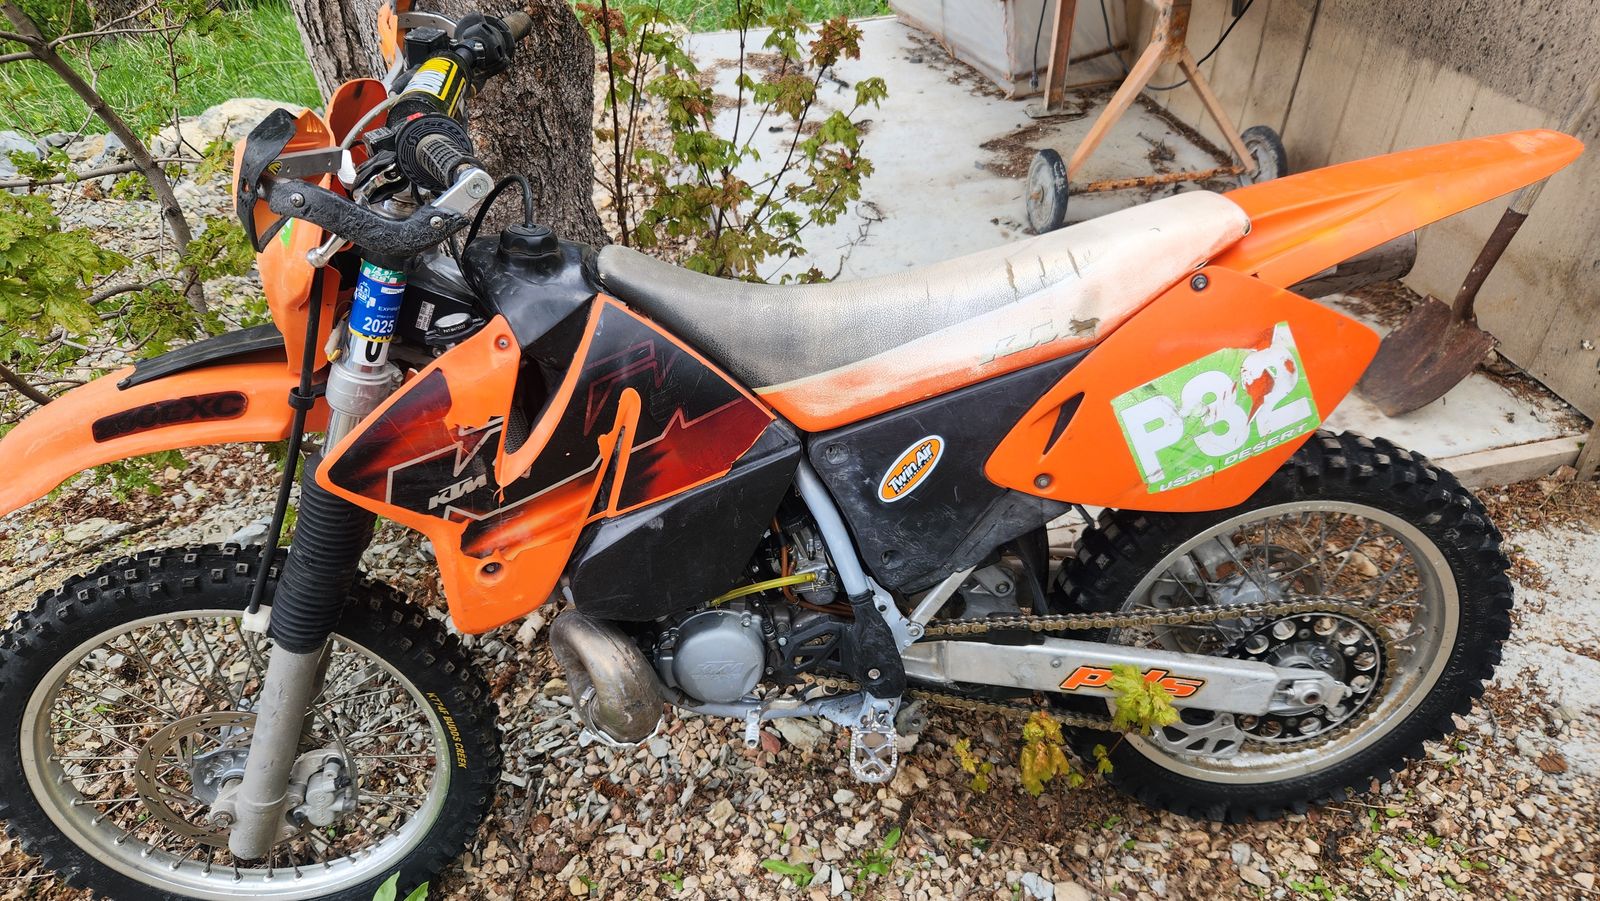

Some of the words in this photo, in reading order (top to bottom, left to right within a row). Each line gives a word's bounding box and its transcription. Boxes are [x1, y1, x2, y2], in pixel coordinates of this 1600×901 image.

[362, 316, 395, 334] 2025
[1120, 346, 1313, 484] P32
[887, 462, 918, 493] Twin
[916, 442, 934, 468] Air
[1159, 464, 1214, 492] USRA
[1224, 423, 1308, 466] DESERT
[428, 473, 488, 510] KTM
[443, 715, 462, 742] BUDDS
[454, 742, 468, 769] CREEK
